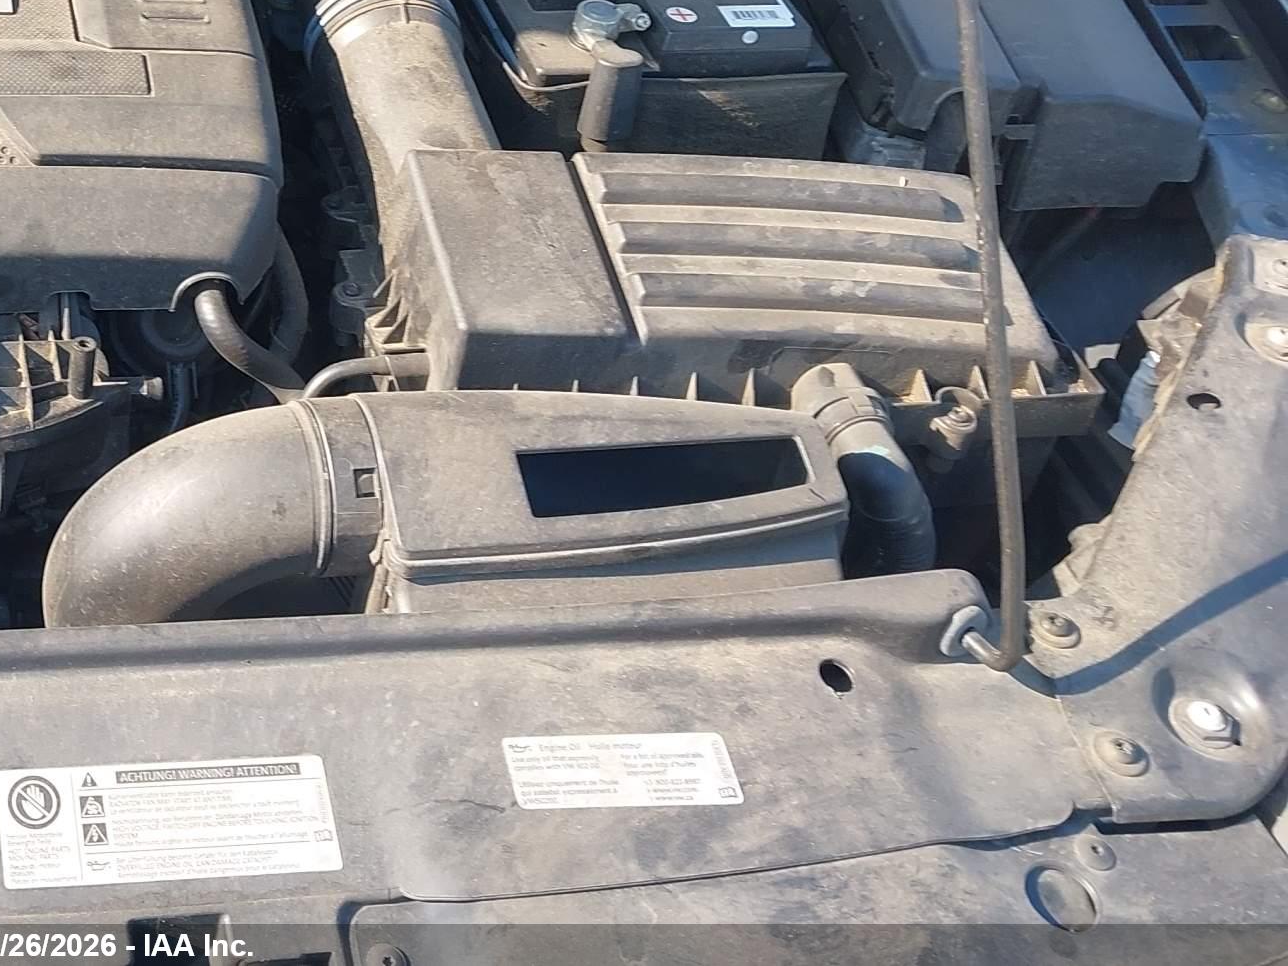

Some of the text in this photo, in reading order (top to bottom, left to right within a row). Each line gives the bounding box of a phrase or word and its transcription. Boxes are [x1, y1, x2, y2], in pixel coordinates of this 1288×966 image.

[119, 764, 297, 782] ACHTUNG! WARNING! ATTENTION!
